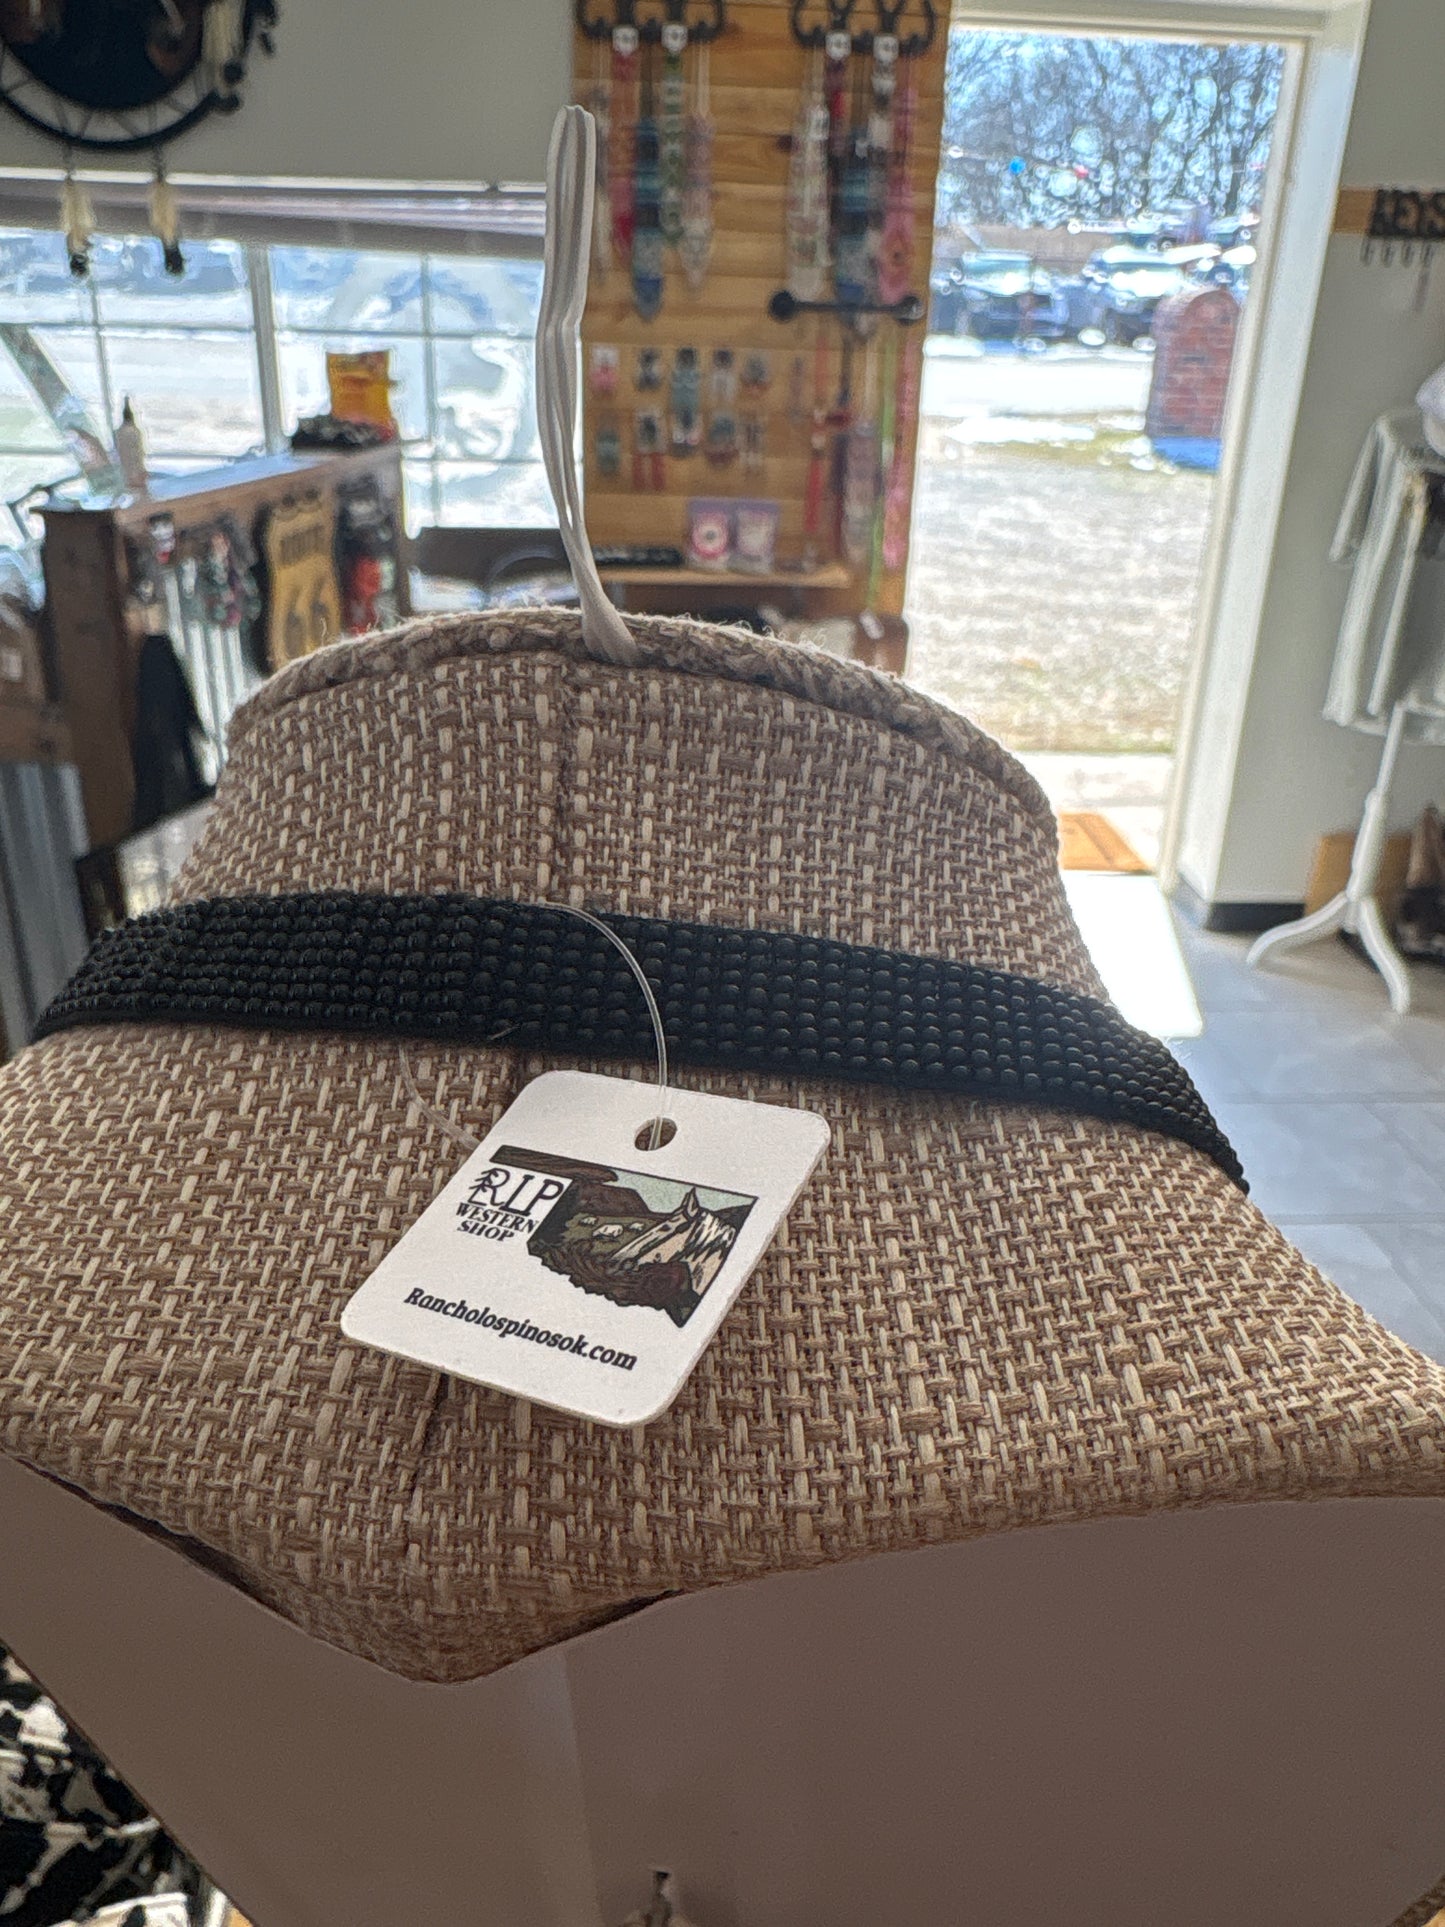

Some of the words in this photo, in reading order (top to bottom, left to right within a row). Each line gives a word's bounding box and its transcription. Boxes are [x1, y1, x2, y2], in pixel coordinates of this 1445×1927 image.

[456, 1202, 540, 1234] WESTERN
[457, 1220, 515, 1241] SHOP
[404, 1287, 637, 1371] Rancholospinosok.com
